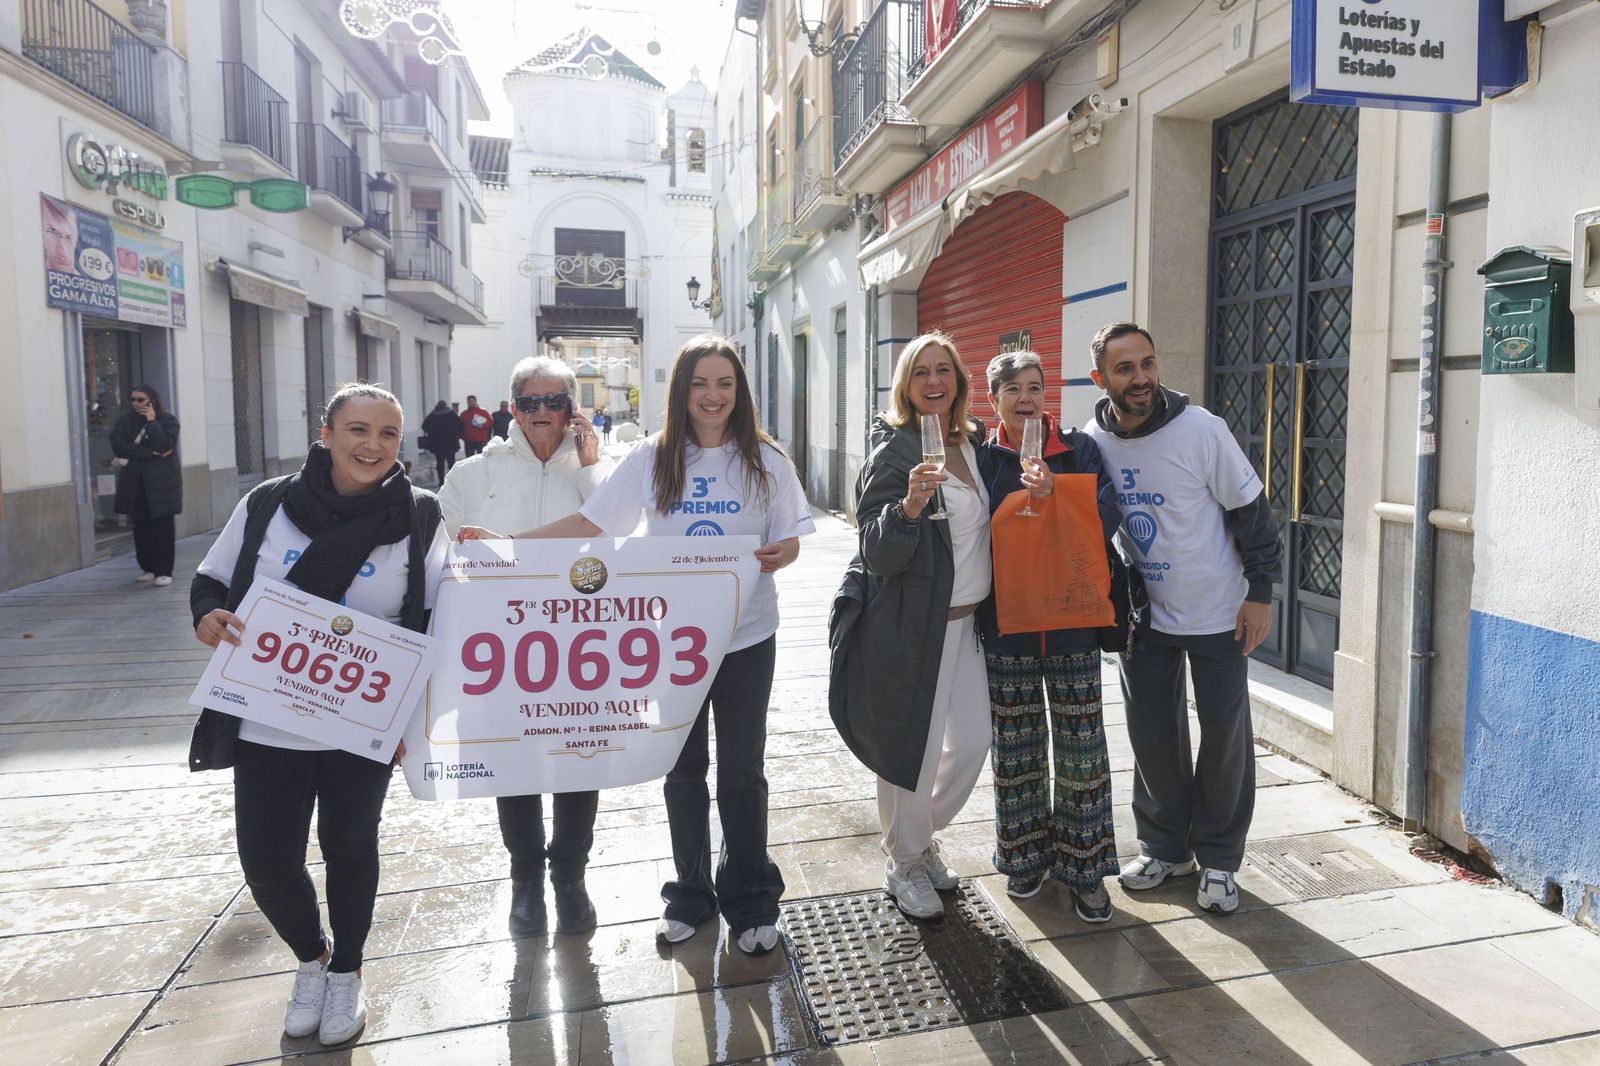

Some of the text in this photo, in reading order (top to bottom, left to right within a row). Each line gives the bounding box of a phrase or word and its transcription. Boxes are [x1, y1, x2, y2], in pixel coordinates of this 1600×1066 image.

[1338, 7, 1420, 37] Loterías y
[1339, 32, 1444, 59] Apuestas del
[1338, 56, 1396, 78] Estado
[949, 122, 989, 191] ESTRELLA
[113, 199, 167, 230] ESPEJO
[49, 271, 116, 296] PROGRESIVOS
[49, 284, 87, 304] GAMA
[89, 294, 116, 309] ALTA
[670, 500, 741, 514] PREMIO
[467, 560, 478, 568] de
[671, 556, 681, 564] 22
[694, 555, 739, 564] Diciembre
[542, 596, 668, 624] PREMIO
[308, 629, 378, 664] PREMIO
[251, 631, 392, 704] 90693
[461, 625, 709, 695] 90693
[276, 675, 319, 697] VENDIDO
[519, 695, 649, 718] VENDIDO AQUÍ
[524, 727, 562, 736] ADMON.
[589, 725, 617, 733] REINA
[619, 722, 650, 731] ISABEL
[565, 739, 609, 749] SANTA FE
[446, 761, 485, 771] LOTERÍA
[446, 770, 495, 779] NACIONAL
